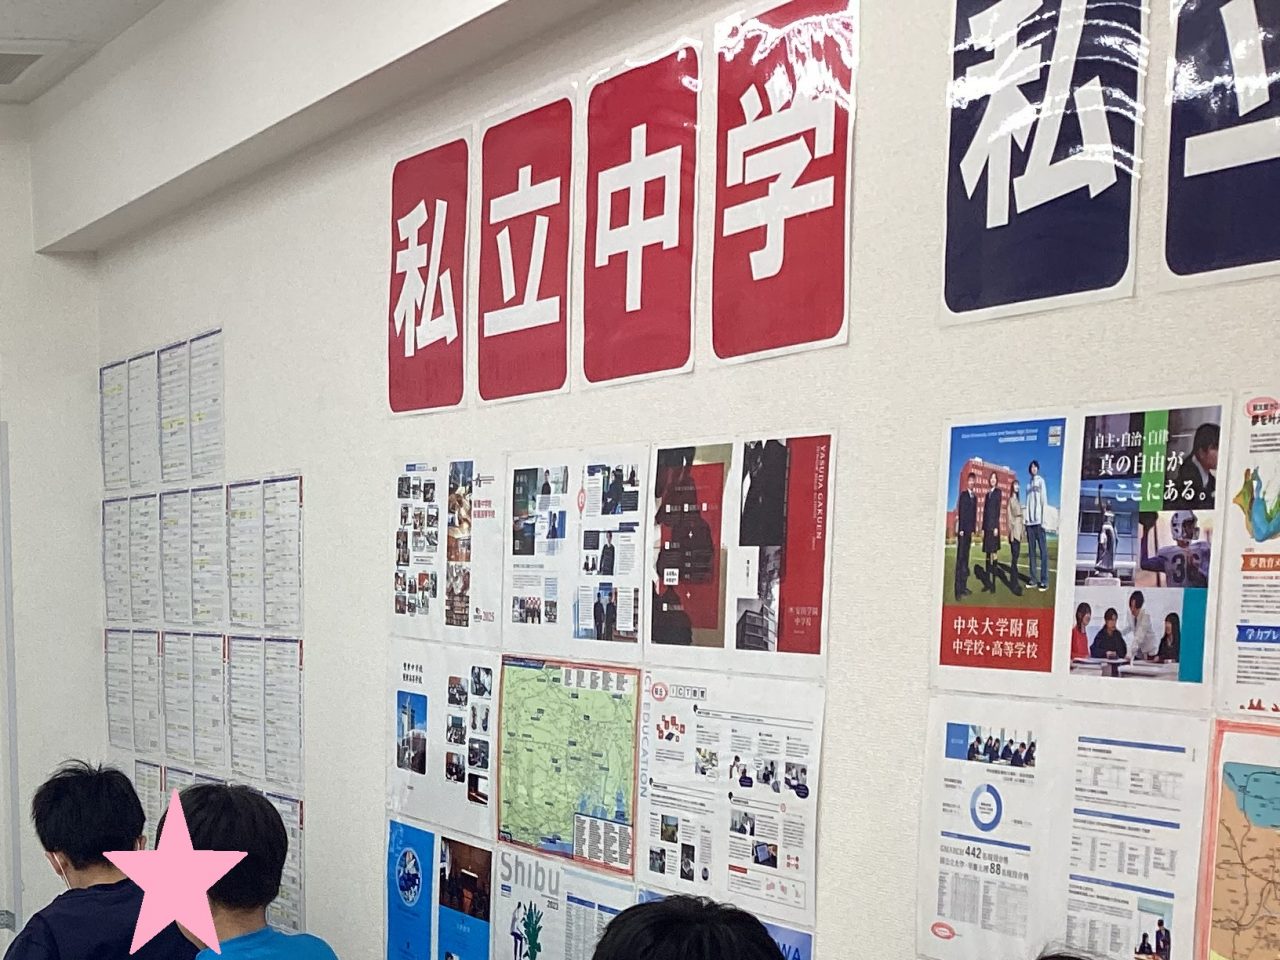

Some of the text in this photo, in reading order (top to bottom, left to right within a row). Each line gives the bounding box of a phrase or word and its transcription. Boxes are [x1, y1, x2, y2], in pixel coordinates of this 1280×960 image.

[393, 83, 834, 357] 私立中学
[1099, 450, 1185, 476] 真の自由が
[1115, 479, 1207, 502] ここにある。
[953, 616, 1040, 639] 中央大学附属
[500, 851, 560, 896] Shibu
